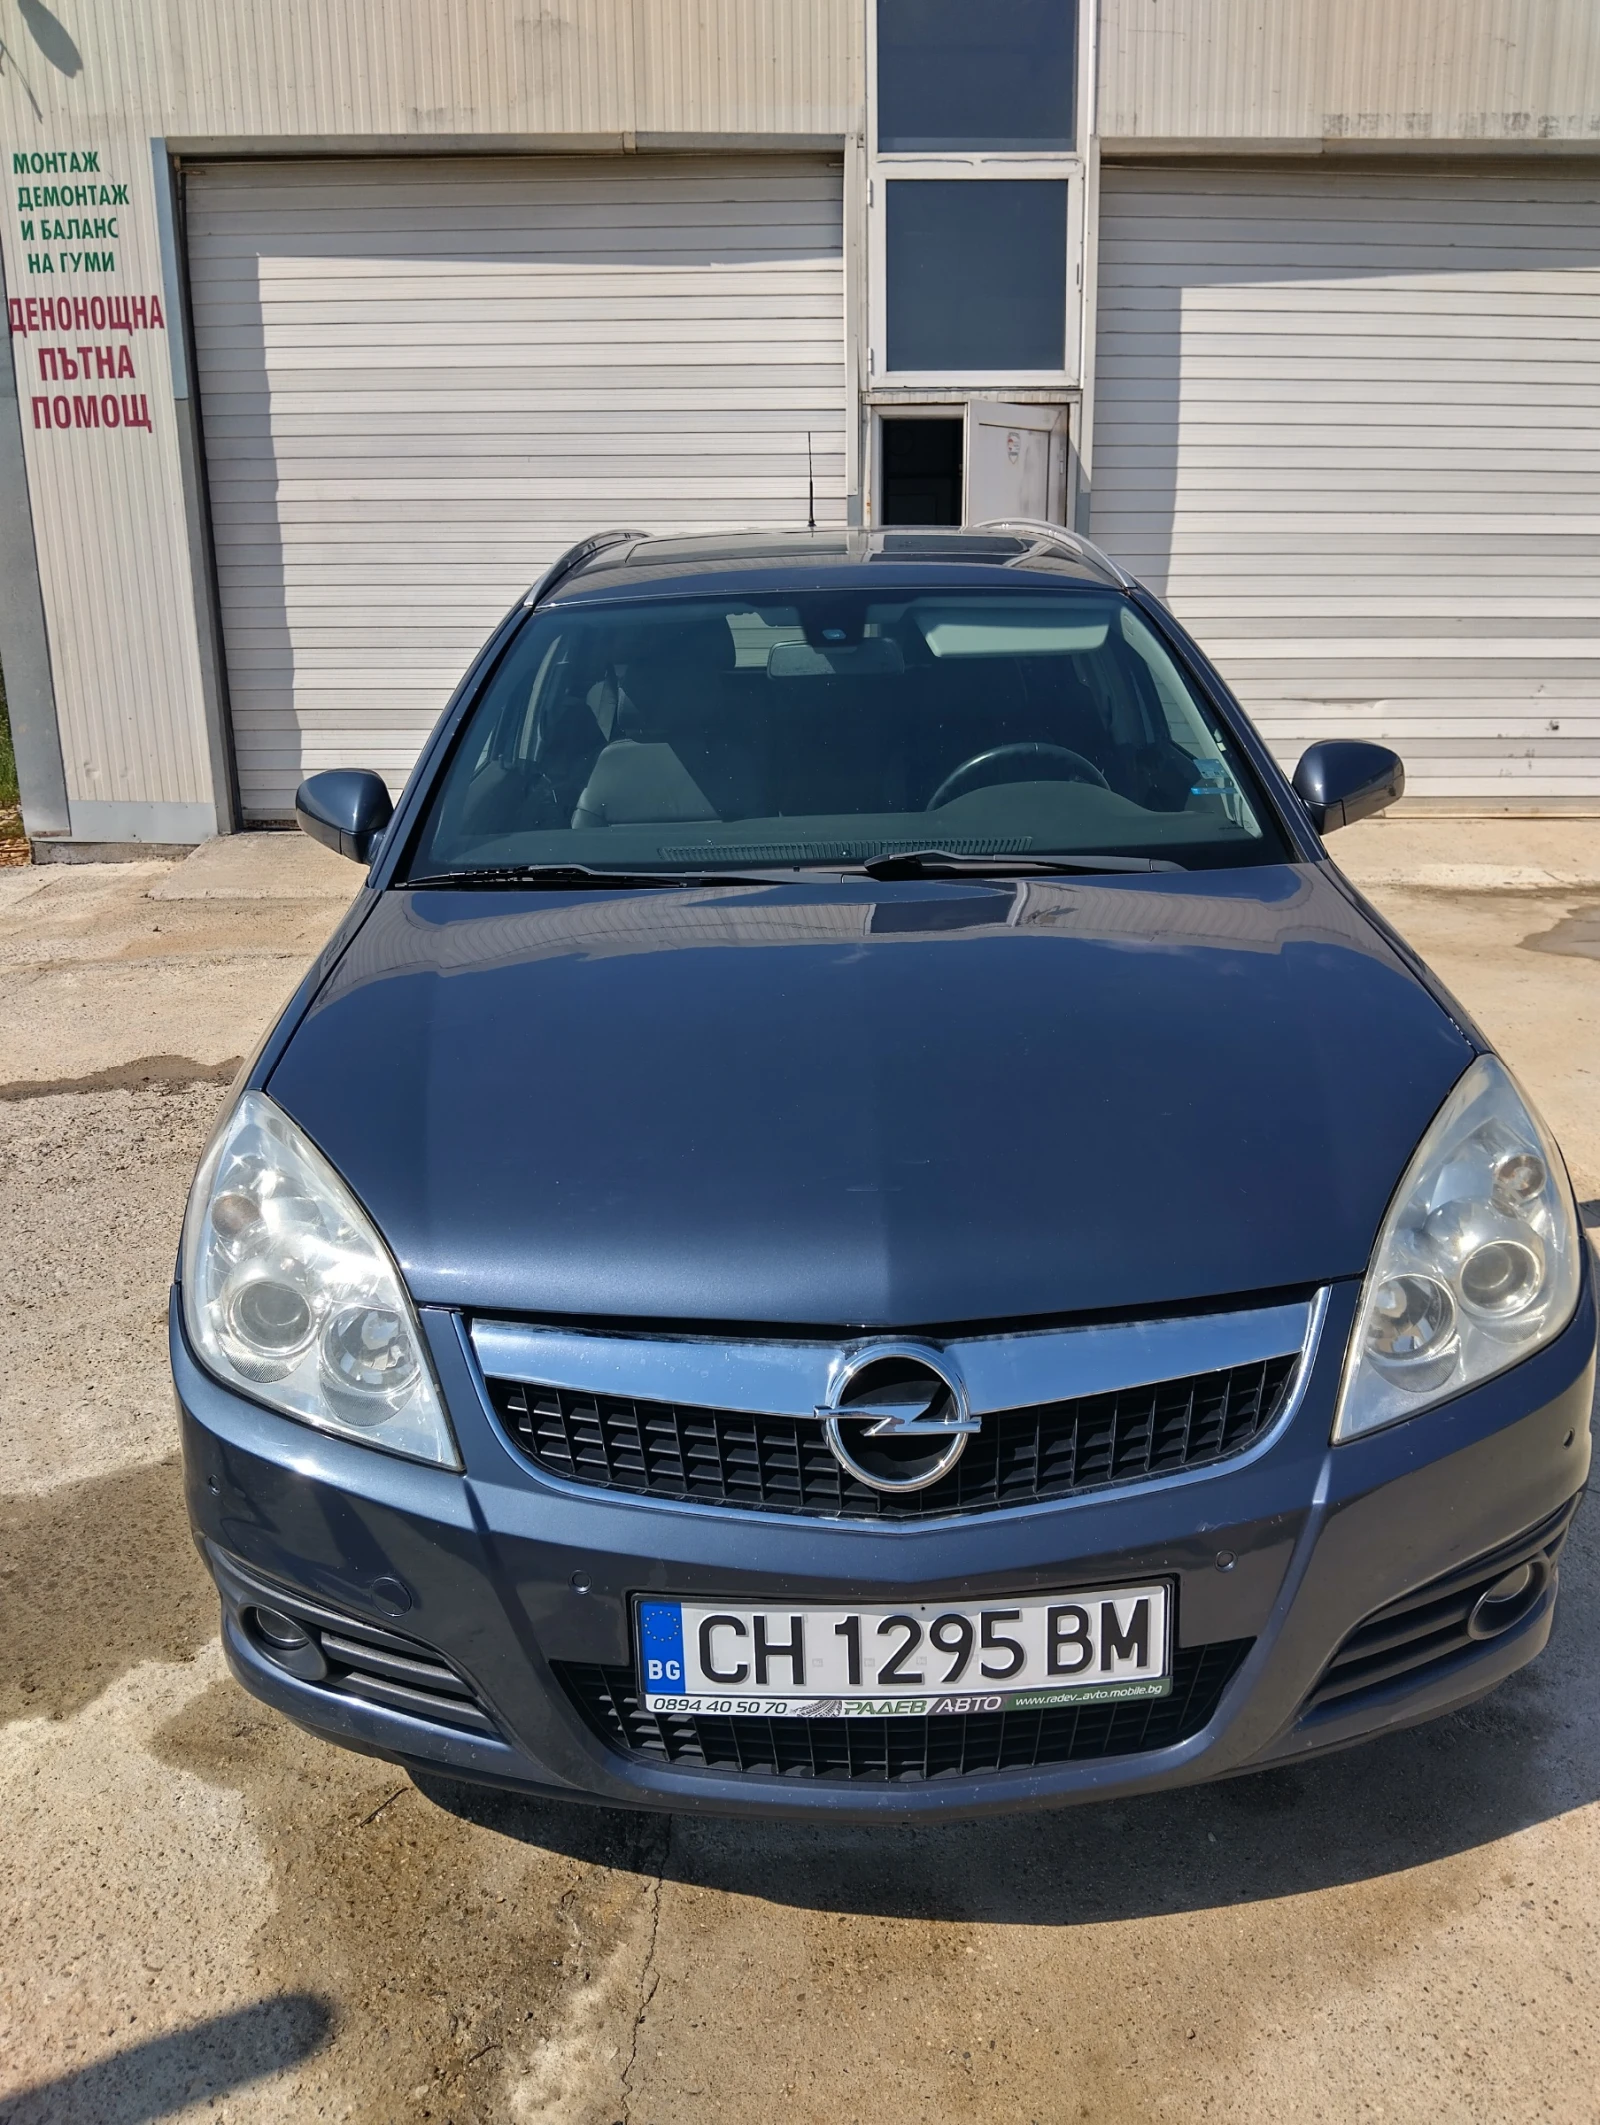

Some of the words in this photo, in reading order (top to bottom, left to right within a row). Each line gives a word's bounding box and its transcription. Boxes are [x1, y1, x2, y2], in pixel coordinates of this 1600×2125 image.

[13, 151, 100, 174] МОНТАЖ
[18, 184, 130, 211] ДЕМОНТАЖ
[21, 220, 34, 240] И
[41, 217, 118, 240] БАЛАНС
[28, 253, 54, 274] НА
[60, 252, 115, 273] ГУМИ
[9, 295, 165, 338] ДЕНОНОЩНА
[37, 345, 135, 381] ПЪТНА
[31, 394, 152, 433] ПОМОЩ
[834, 1609, 1024, 1685] 1295
[647, 1660, 681, 1680] BG
[653, 1698, 701, 1712] 0894
[706, 1700, 732, 1713] 40
[736, 1701, 760, 1714] 50
[764, 1702, 787, 1714] 70
[843, 1700, 927, 1715] РАДЕВ
[936, 1697, 1001, 1712] АВТО
[1015, 1685, 1163, 1706] www.radev_avto.mobile.bg
